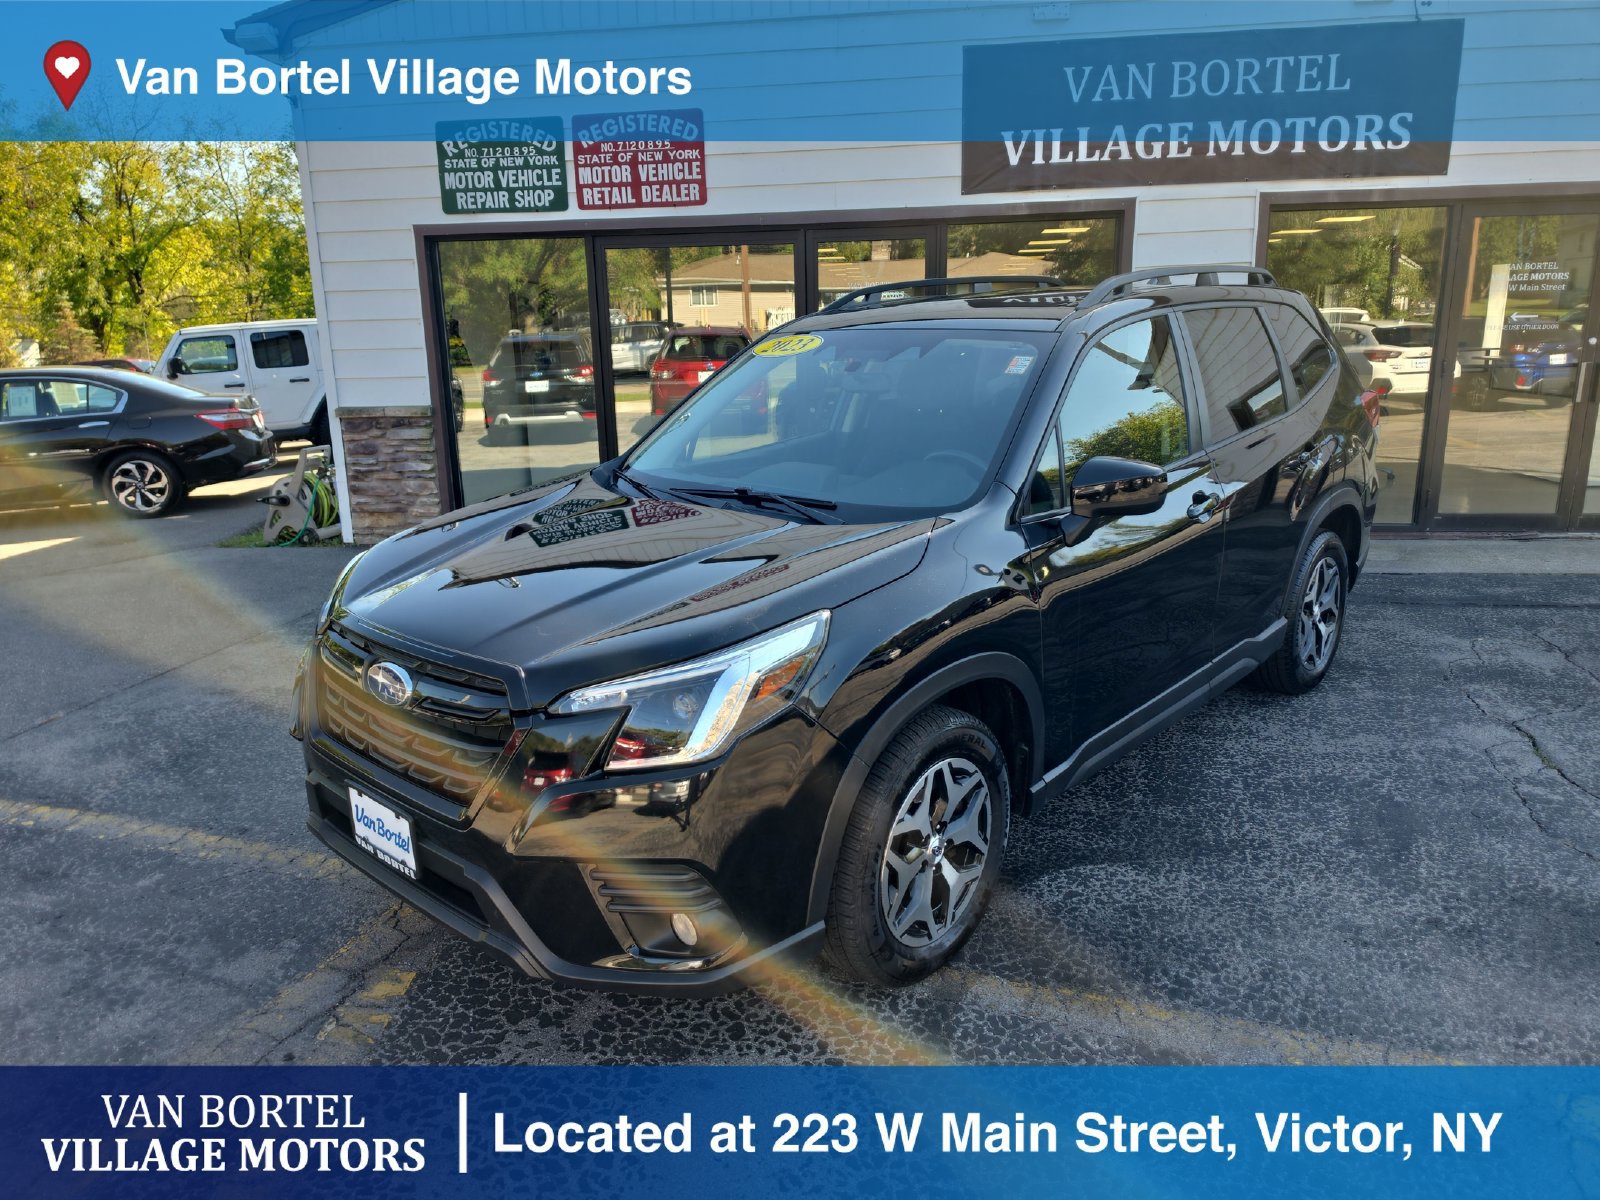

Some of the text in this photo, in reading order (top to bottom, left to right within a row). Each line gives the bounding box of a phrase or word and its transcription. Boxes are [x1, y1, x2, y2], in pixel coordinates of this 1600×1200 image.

[1064, 53, 1351, 103] VAN BORTEL
[442, 120, 557, 157] REGISTERED
[577, 113, 699, 148] REGISTERED
[1001, 112, 1414, 167] VILLAGE MOTORS
[464, 146, 536, 158] NO. 7120895
[577, 149, 701, 165] STATE OF NEW YORK
[600, 140, 672, 153] NO. 7120895
[444, 155, 559, 169] STATE OF NEW YORK
[578, 161, 702, 185] MOTOR VEHICLE
[444, 168, 562, 190] MOTOR VEHICLE
[456, 188, 555, 210] REPAIR SHOP
[582, 183, 700, 205] RETAIL DEALER
[1525, 262, 1559, 270] BORTEL
[1530, 272, 1570, 280] MOTORS
[761, 338, 815, 353] 2023
